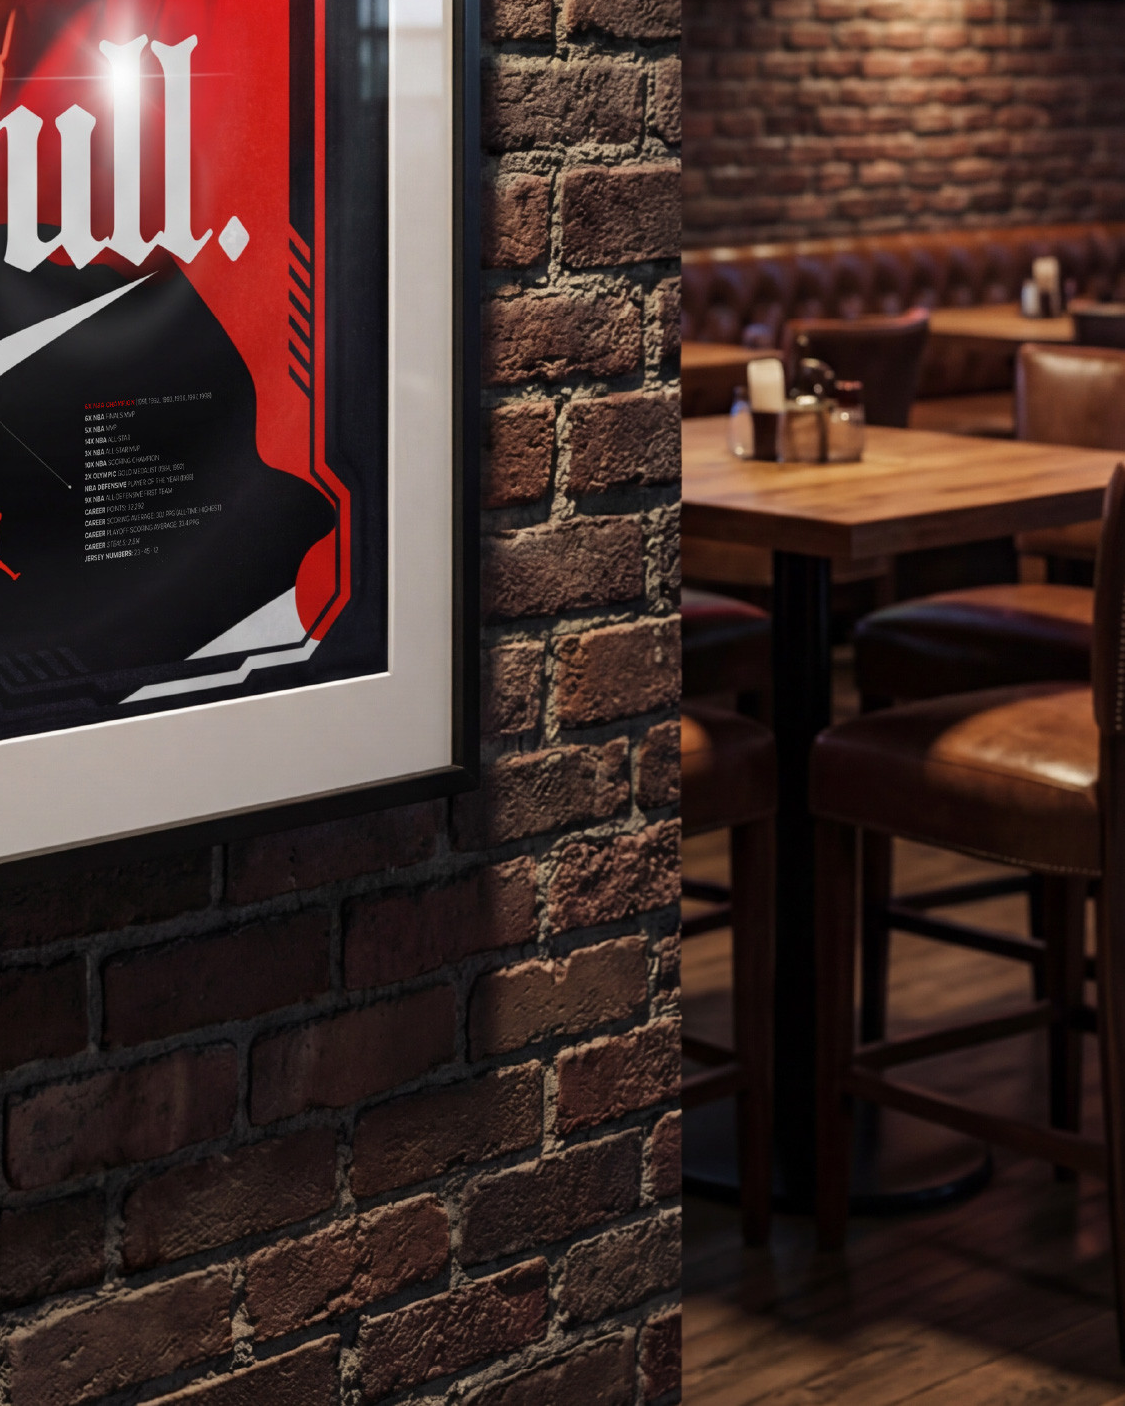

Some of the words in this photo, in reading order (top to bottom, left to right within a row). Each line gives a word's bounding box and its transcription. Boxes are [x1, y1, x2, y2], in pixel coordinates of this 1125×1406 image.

[84, 414, 92, 422] 6X
[93, 413, 104, 421] NBA
[84, 426, 92, 434] 5X
[93, 425, 104, 433] NBA
[93, 448, 104, 456] NBA
[95, 459, 107, 467] NBA
[92, 470, 116, 479] OLYMPIC
[84, 483, 96, 492] NBA
[97, 480, 126, 490] DEFENSIVE
[93, 494, 104, 503] NBA
[84, 506, 105, 516] CAREER
[84, 517, 105, 527] CAREER
[84, 529, 105, 539] CAREER
[84, 541, 105, 551] CAREER
[84, 552, 104, 562] JERSEY
